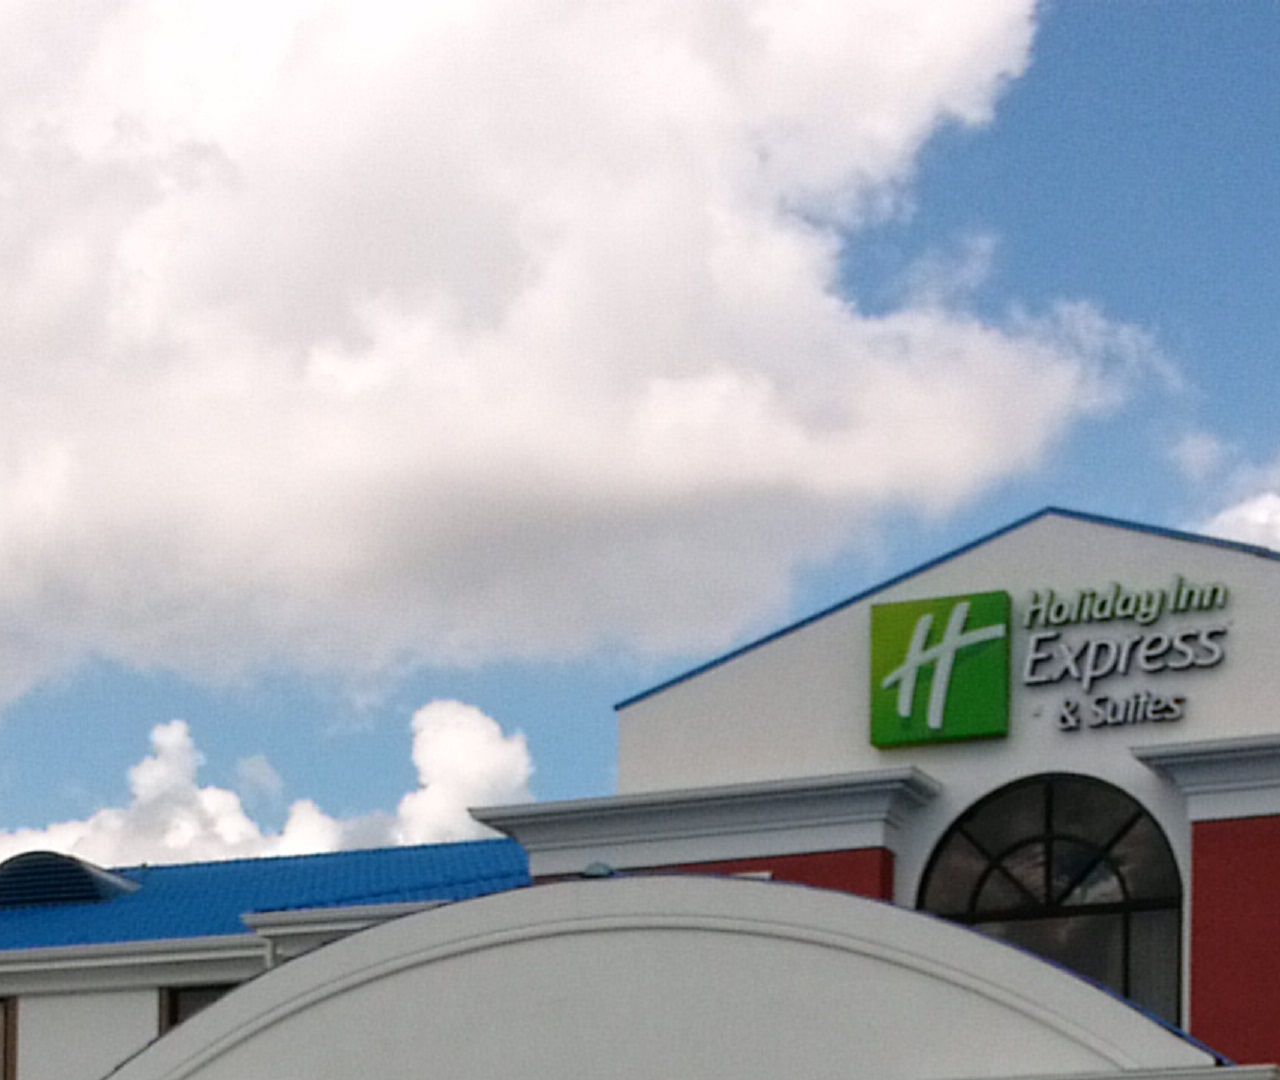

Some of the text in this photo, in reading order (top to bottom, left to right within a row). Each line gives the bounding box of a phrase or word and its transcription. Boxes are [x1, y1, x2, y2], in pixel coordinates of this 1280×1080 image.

[1023, 575, 1229, 628] Holiday Inn
[1023, 627, 1228, 694] Express
[1057, 691, 1187, 732] & Suites
